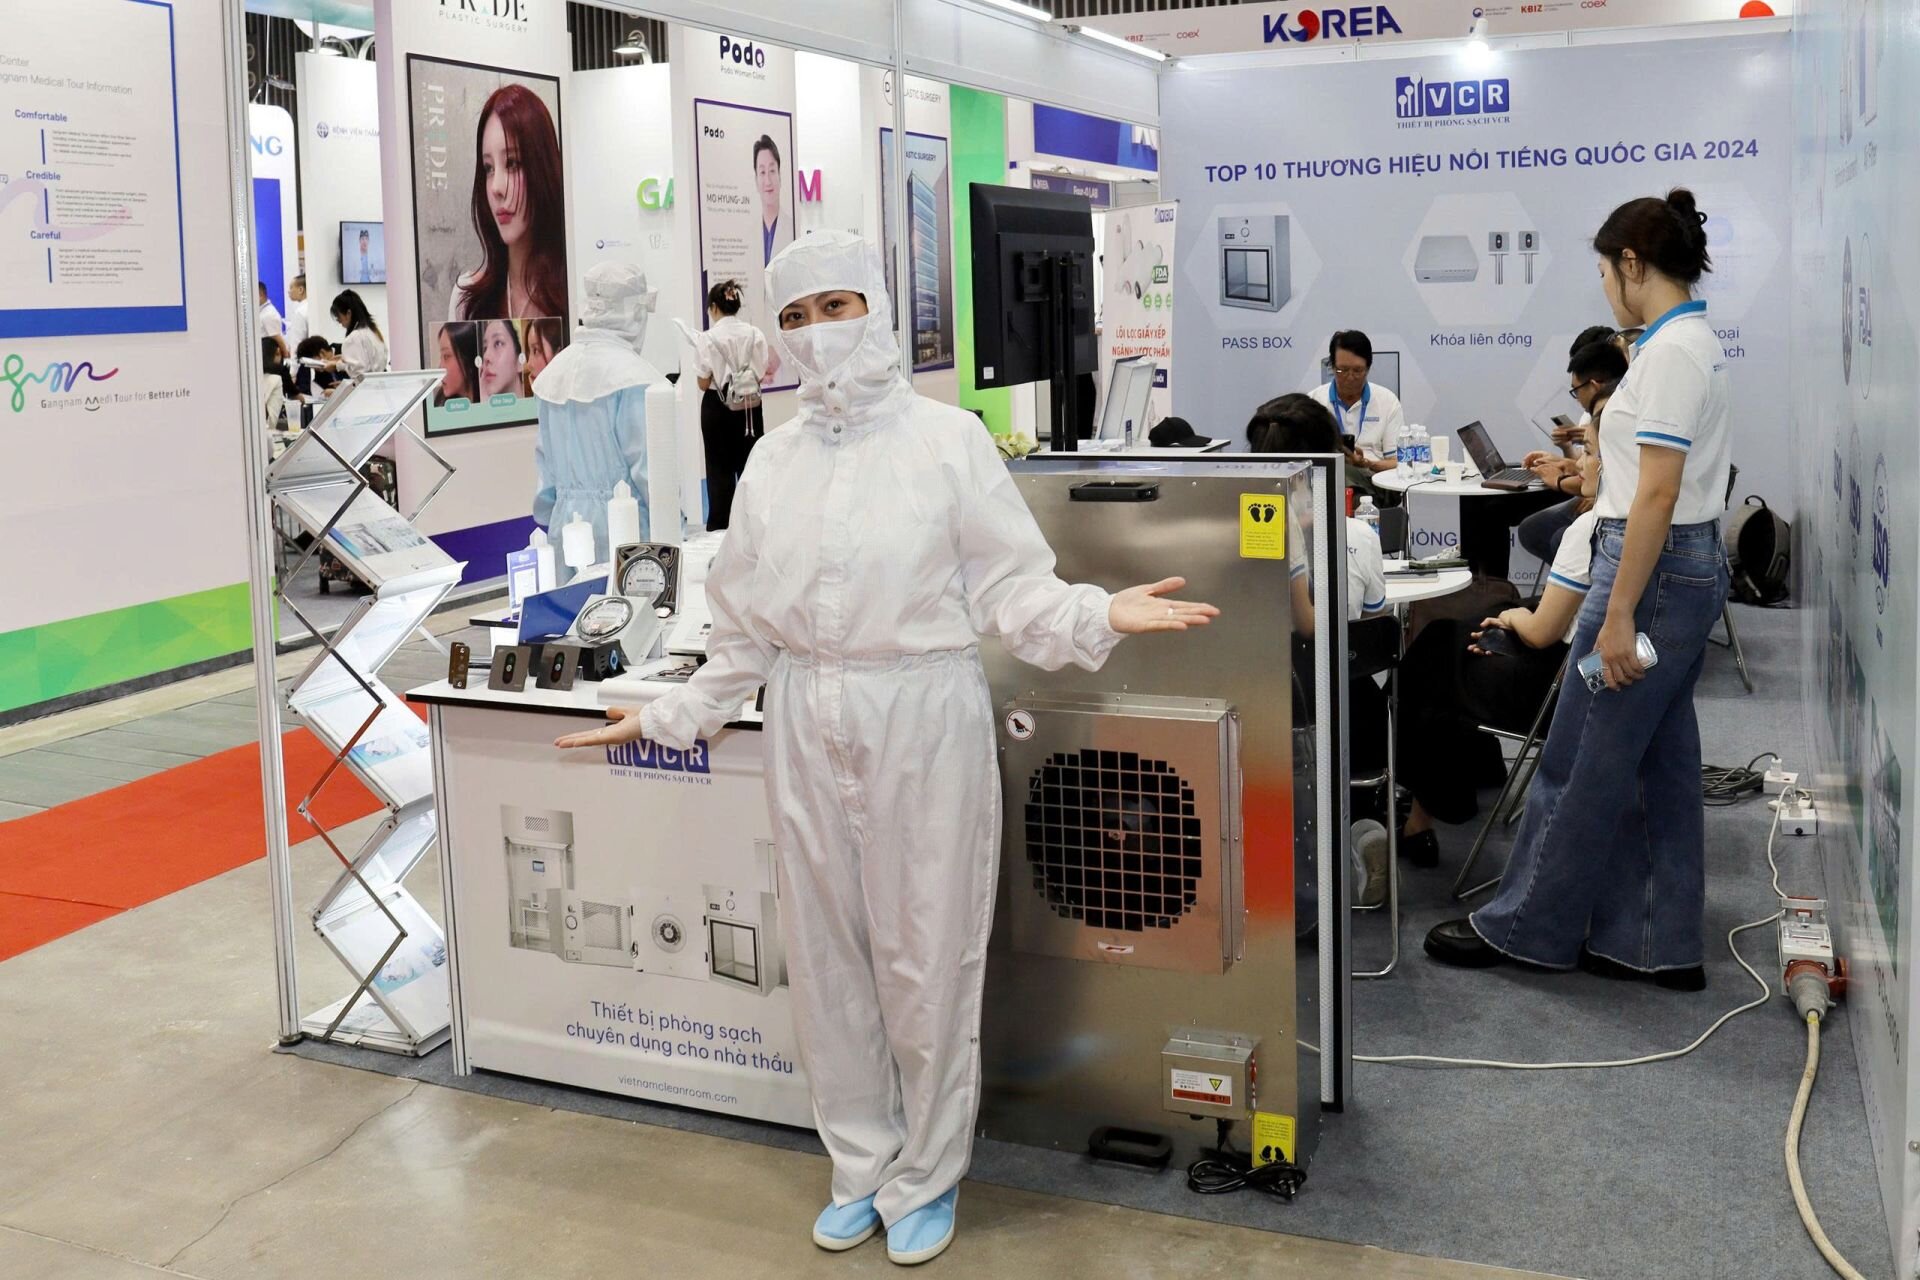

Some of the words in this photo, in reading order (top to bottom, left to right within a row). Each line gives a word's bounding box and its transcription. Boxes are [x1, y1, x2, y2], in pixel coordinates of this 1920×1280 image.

[1521, 4, 1543, 14] KBIZ
[439, 10, 481, 25] PLASTIC
[486, 18, 528, 33] SURGERY
[1264, 6, 1402, 43] KOREA
[719, 35, 765, 68] Podo
[30, 74, 64, 88] Medical
[66, 78, 85, 90] Tour
[87, 81, 133, 96] Information
[1428, 83, 1504, 109] VCR
[14, 109, 68, 123] Comfortable
[1435, 117, 1466, 127] PHÒNG
[1467, 116, 1491, 127] SẠCH
[1492, 116, 1511, 124] VCR
[704, 125, 724, 139] Podo
[1204, 164, 1248, 183] TOP
[1254, 163, 1277, 180] 10
[1283, 157, 1382, 179] THƯƠNG
[1389, 153, 1441, 177] HIỆU
[1450, 148, 1489, 171] NỔI
[1496, 146, 1567, 169] TIẾNG
[1575, 139, 1646, 166] QUỐC
[1654, 142, 1697, 162] GIA
[1703, 138, 1759, 160] 2024
[26, 170, 61, 181] Credible
[30, 231, 61, 240] Careful
[1155, 267, 1168, 280] FDA
[1222, 337, 1259, 349] PASS
[1262, 336, 1292, 349] BOX
[1430, 333, 1466, 347] Khóa
[1469, 333, 1493, 346] liên
[1498, 333, 1532, 348] động
[40, 397, 83, 410] Gangnam
[115, 393, 133, 403] Tour
[135, 392, 147, 401] for
[148, 389, 174, 400] Better
[175, 387, 191, 398] Life
[1872, 512, 1890, 588] ISO
[643, 771, 671, 782] PHÒNG
[672, 774, 694, 785] SẠCH
[694, 776, 712, 786] VCR
[591, 1000, 639, 1024] Thiết
[639, 1009, 654, 1031] bị
[659, 1015, 714, 1040] phòng
[719, 1025, 762, 1045] sạch
[566, 1022, 625, 1046] chuyên
[630, 1032, 672, 1057] dụng
[677, 1041, 709, 1060] cho
[714, 1049, 747, 1067] nhà
[752, 1051, 793, 1075] thầu
[618, 1074, 738, 1105] vietnamcleanroom.com
